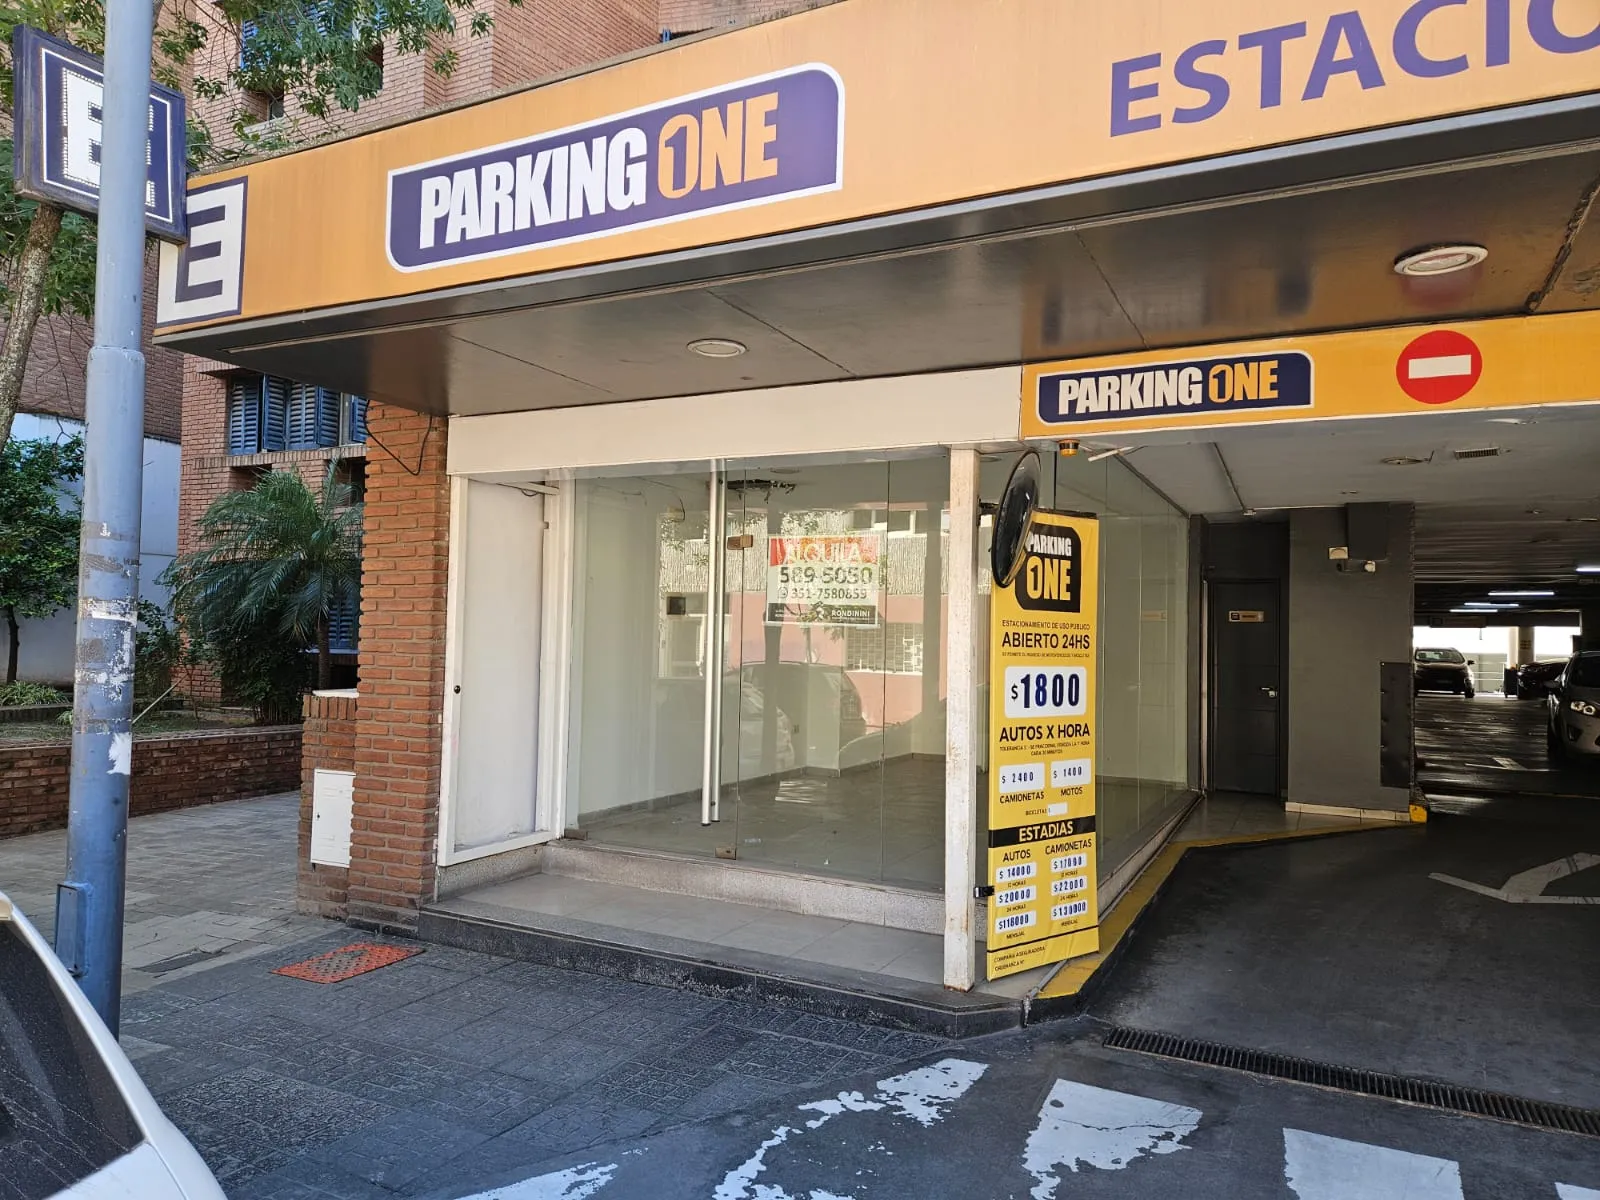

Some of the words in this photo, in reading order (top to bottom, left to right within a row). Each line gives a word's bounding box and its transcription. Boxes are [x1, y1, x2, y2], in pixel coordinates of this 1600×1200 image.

[420, 127, 648, 249] PARKING
[657, 92, 779, 199] ONE
[1058, 366, 1203, 415] PARKING
[1208, 360, 1279, 404] ONE
[1026, 555, 1071, 600] ONE
[831, 609, 870, 618] RONDININI
[1002, 631, 1059, 649] ABIERTO
[1062, 633, 1090, 650] 24HS
[999, 725, 1043, 742] AUTOS
[1046, 724, 1055, 740] X
[1057, 722, 1090, 738] HORA
[1000, 791, 1045, 804] CAMIONETAS
[1060, 786, 1083, 797] MOTOS
[1019, 820, 1074, 842] ESTADIAS
[1002, 848, 1031, 863] AUTOS
[1045, 838, 1092, 855] CAMIONETAS
